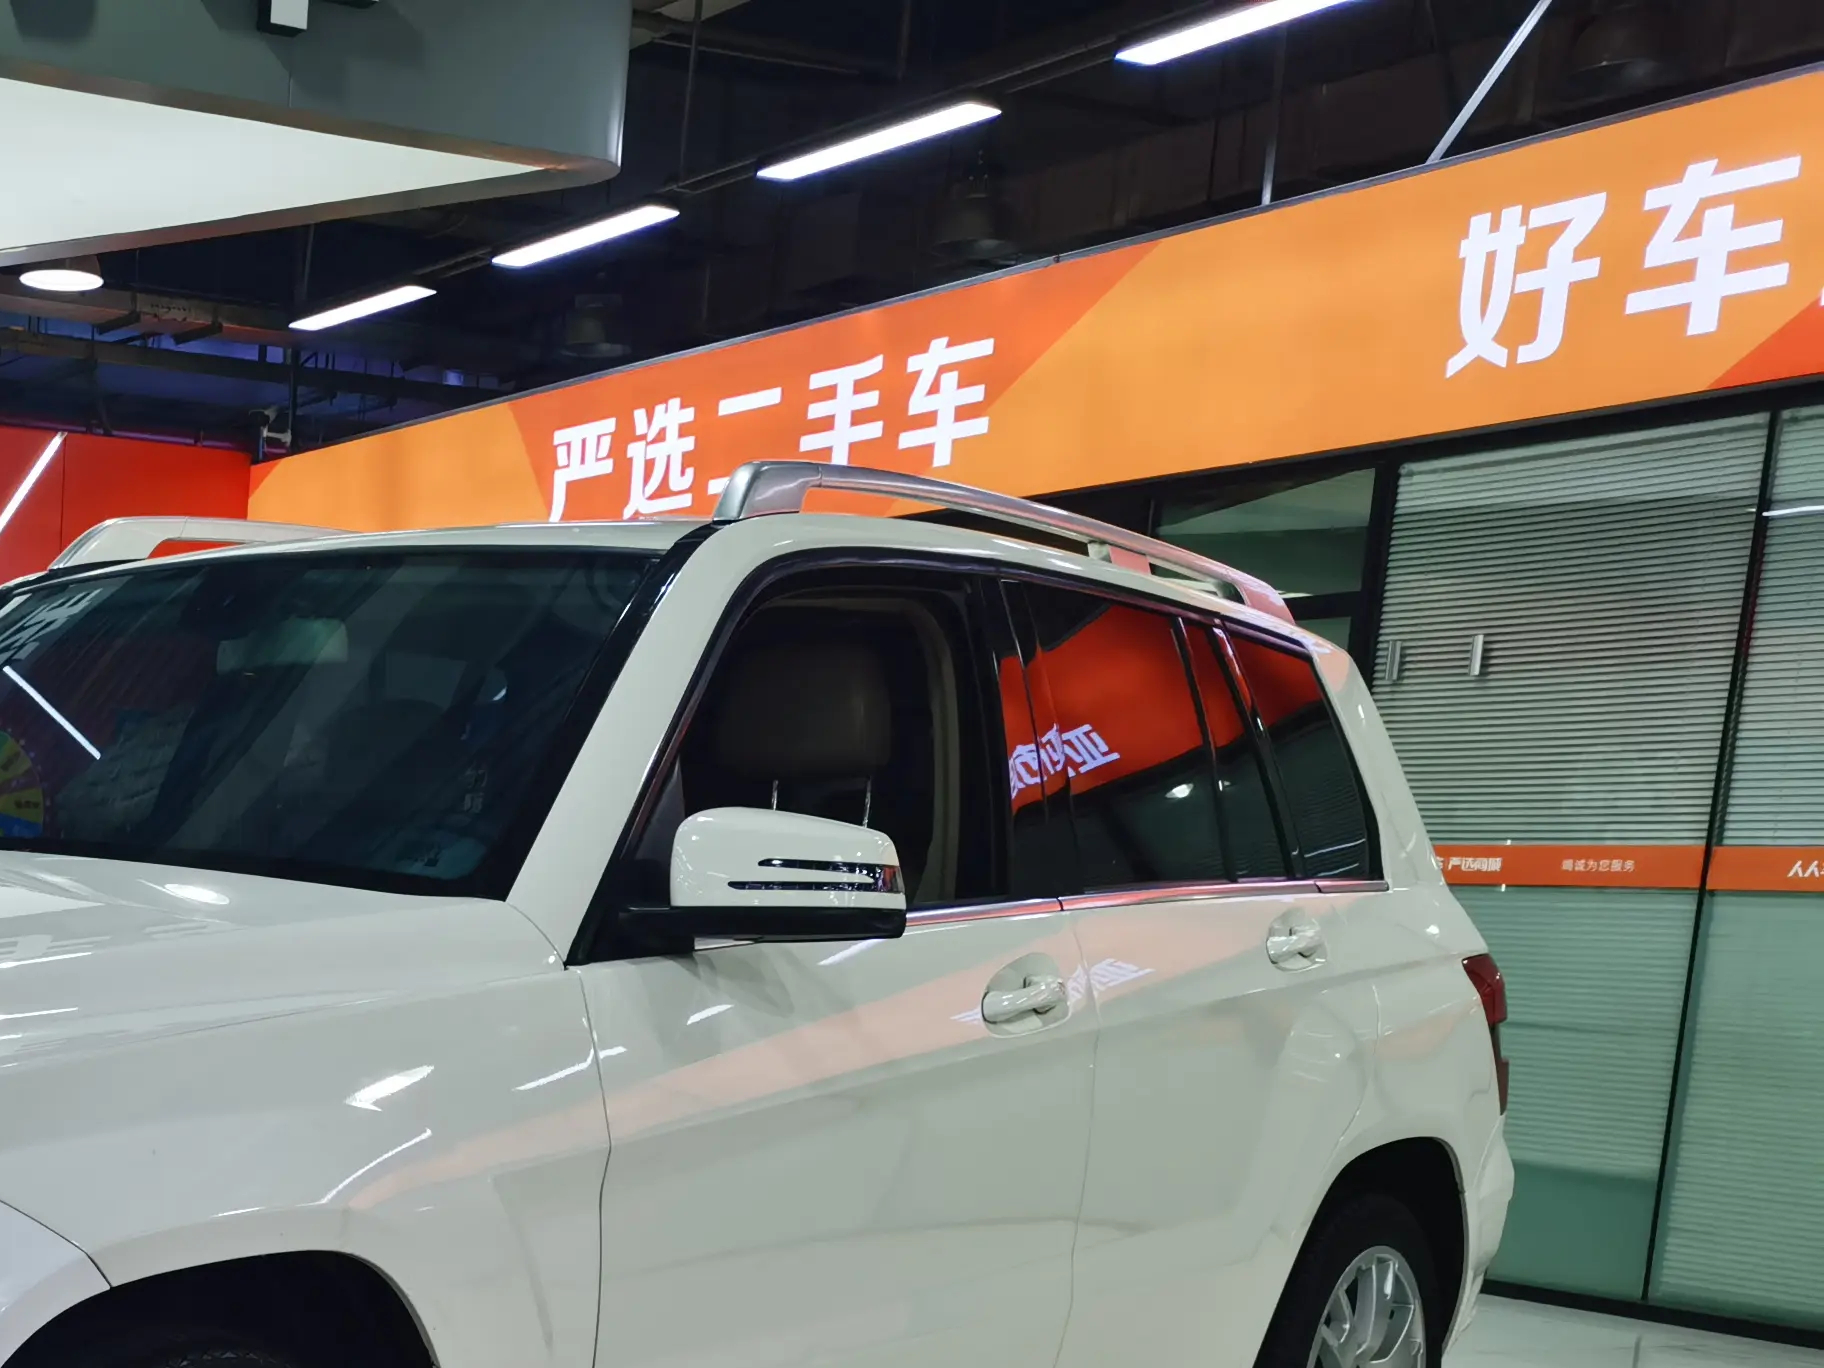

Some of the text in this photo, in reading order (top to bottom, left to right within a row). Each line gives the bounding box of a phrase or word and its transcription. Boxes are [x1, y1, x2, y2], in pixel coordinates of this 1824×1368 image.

[1446, 156, 1802, 378] 好车
[549, 337, 995, 522] 严选二手车
[1787, 860, 1824, 878] 人人
